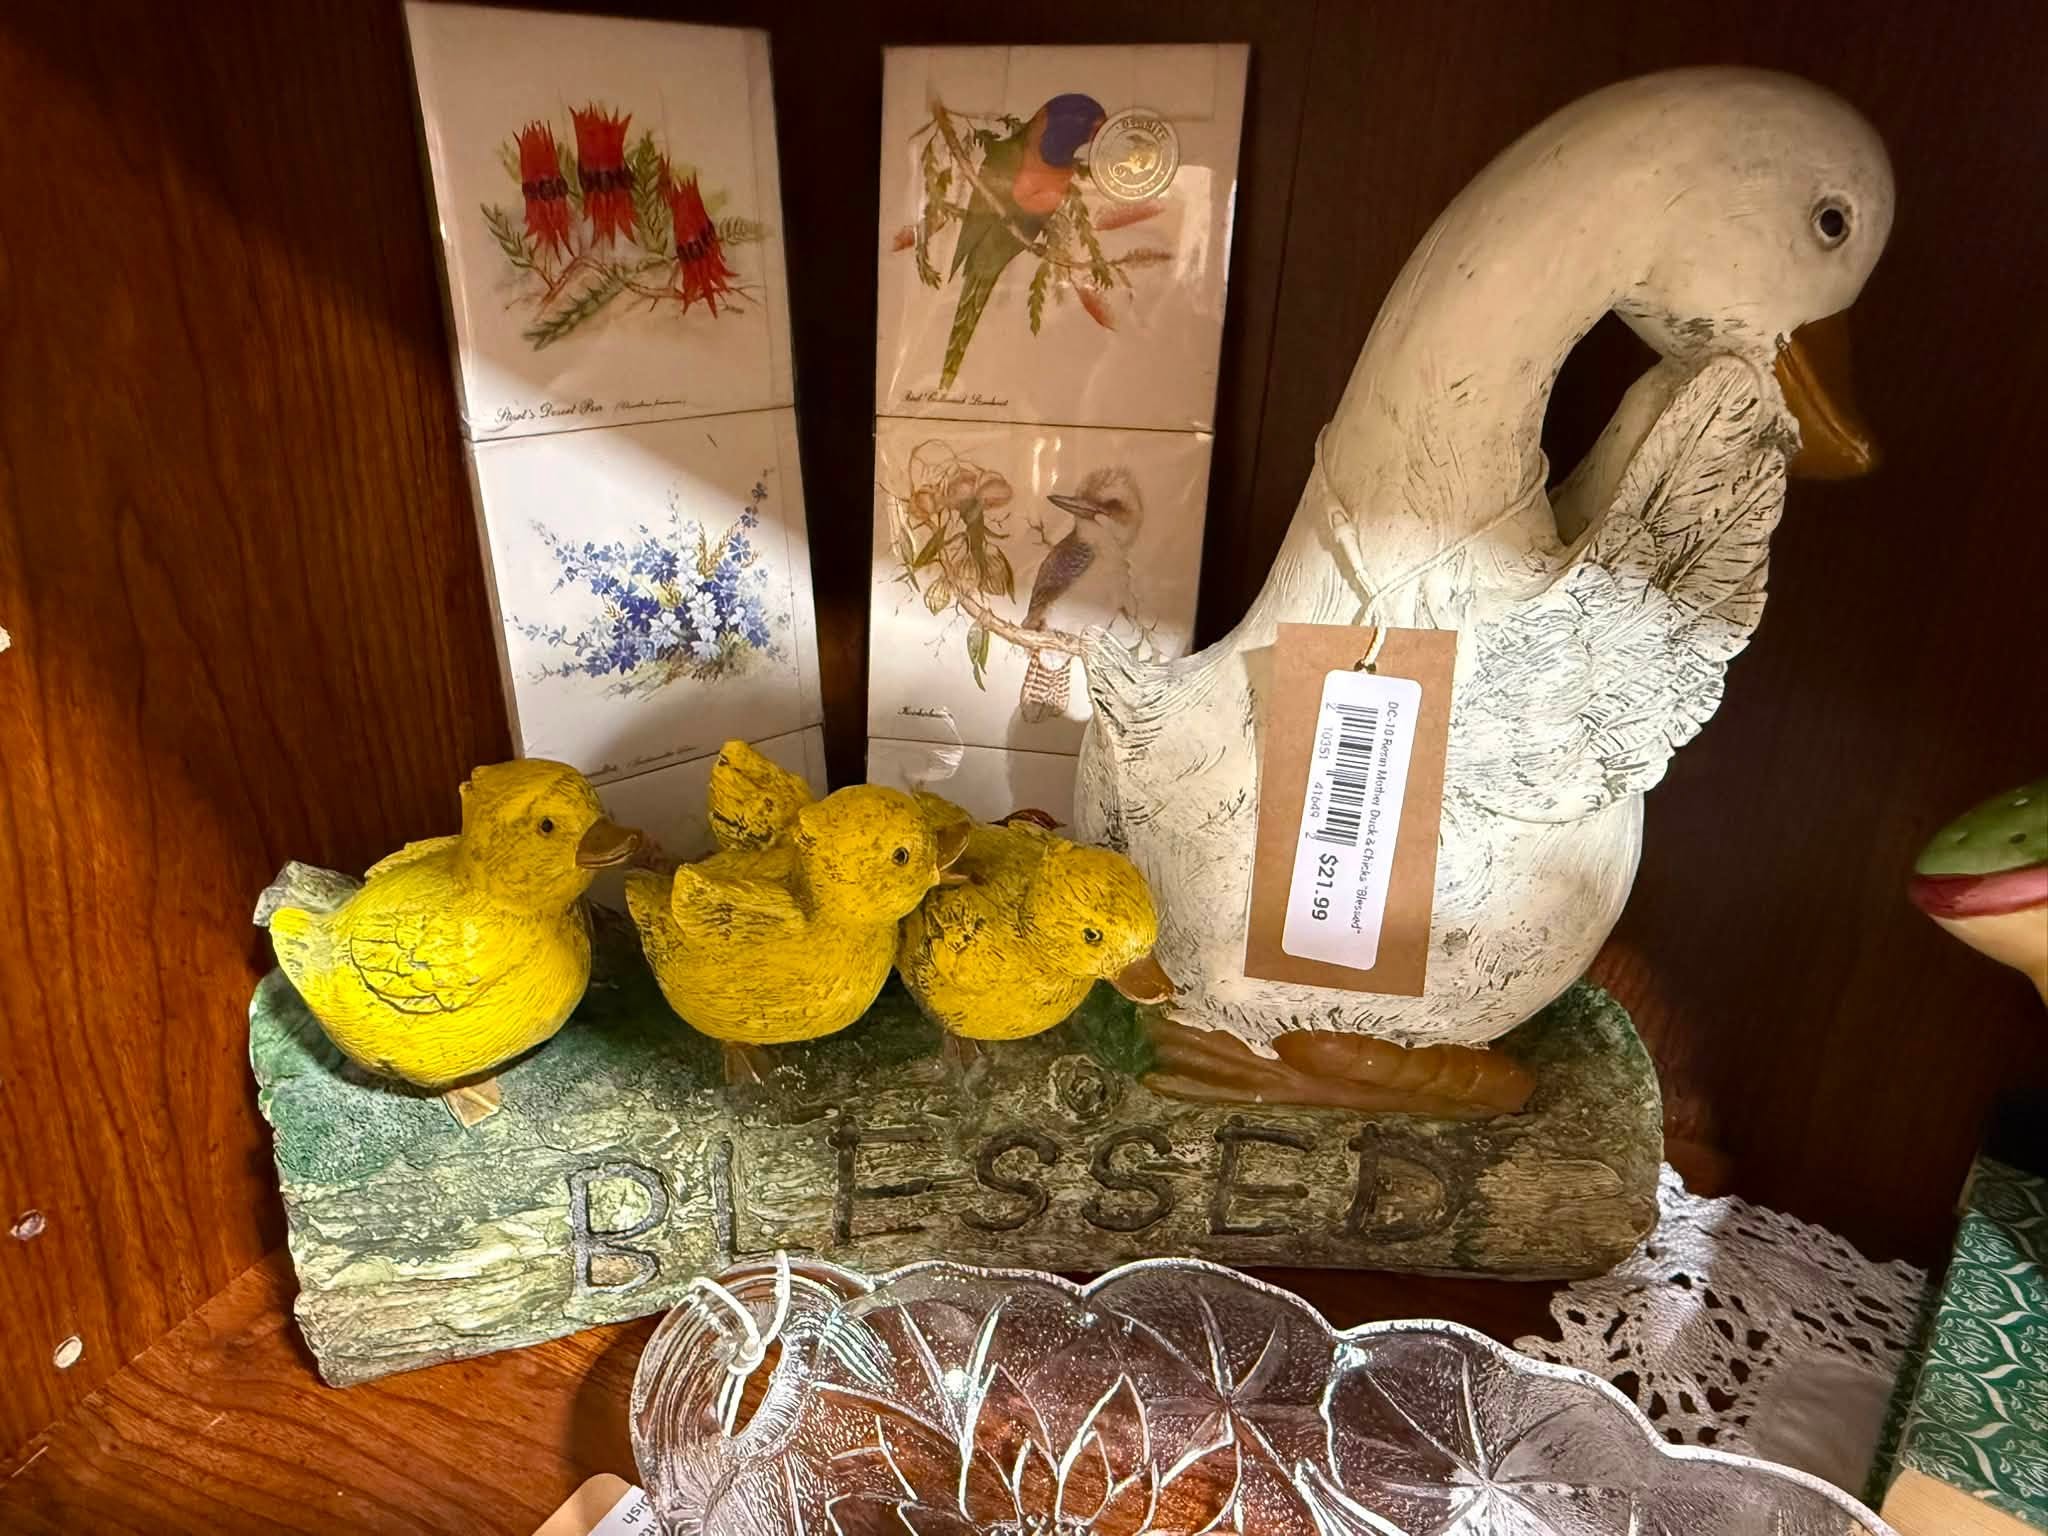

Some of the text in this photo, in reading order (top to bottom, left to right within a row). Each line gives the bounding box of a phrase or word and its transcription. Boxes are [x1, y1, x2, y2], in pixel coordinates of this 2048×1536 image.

[1383, 701, 1399, 736] DC-10
[1319, 727, 1334, 760] 10351
[1379, 738, 1393, 768] Resin
[1371, 769, 1388, 806] Mother
[1367, 809, 1381, 837] Duck
[1360, 849, 1374, 882] Chicks
[1311, 852, 1339, 921] $21.99
[568, 1112, 1468, 1297] BLESSED
